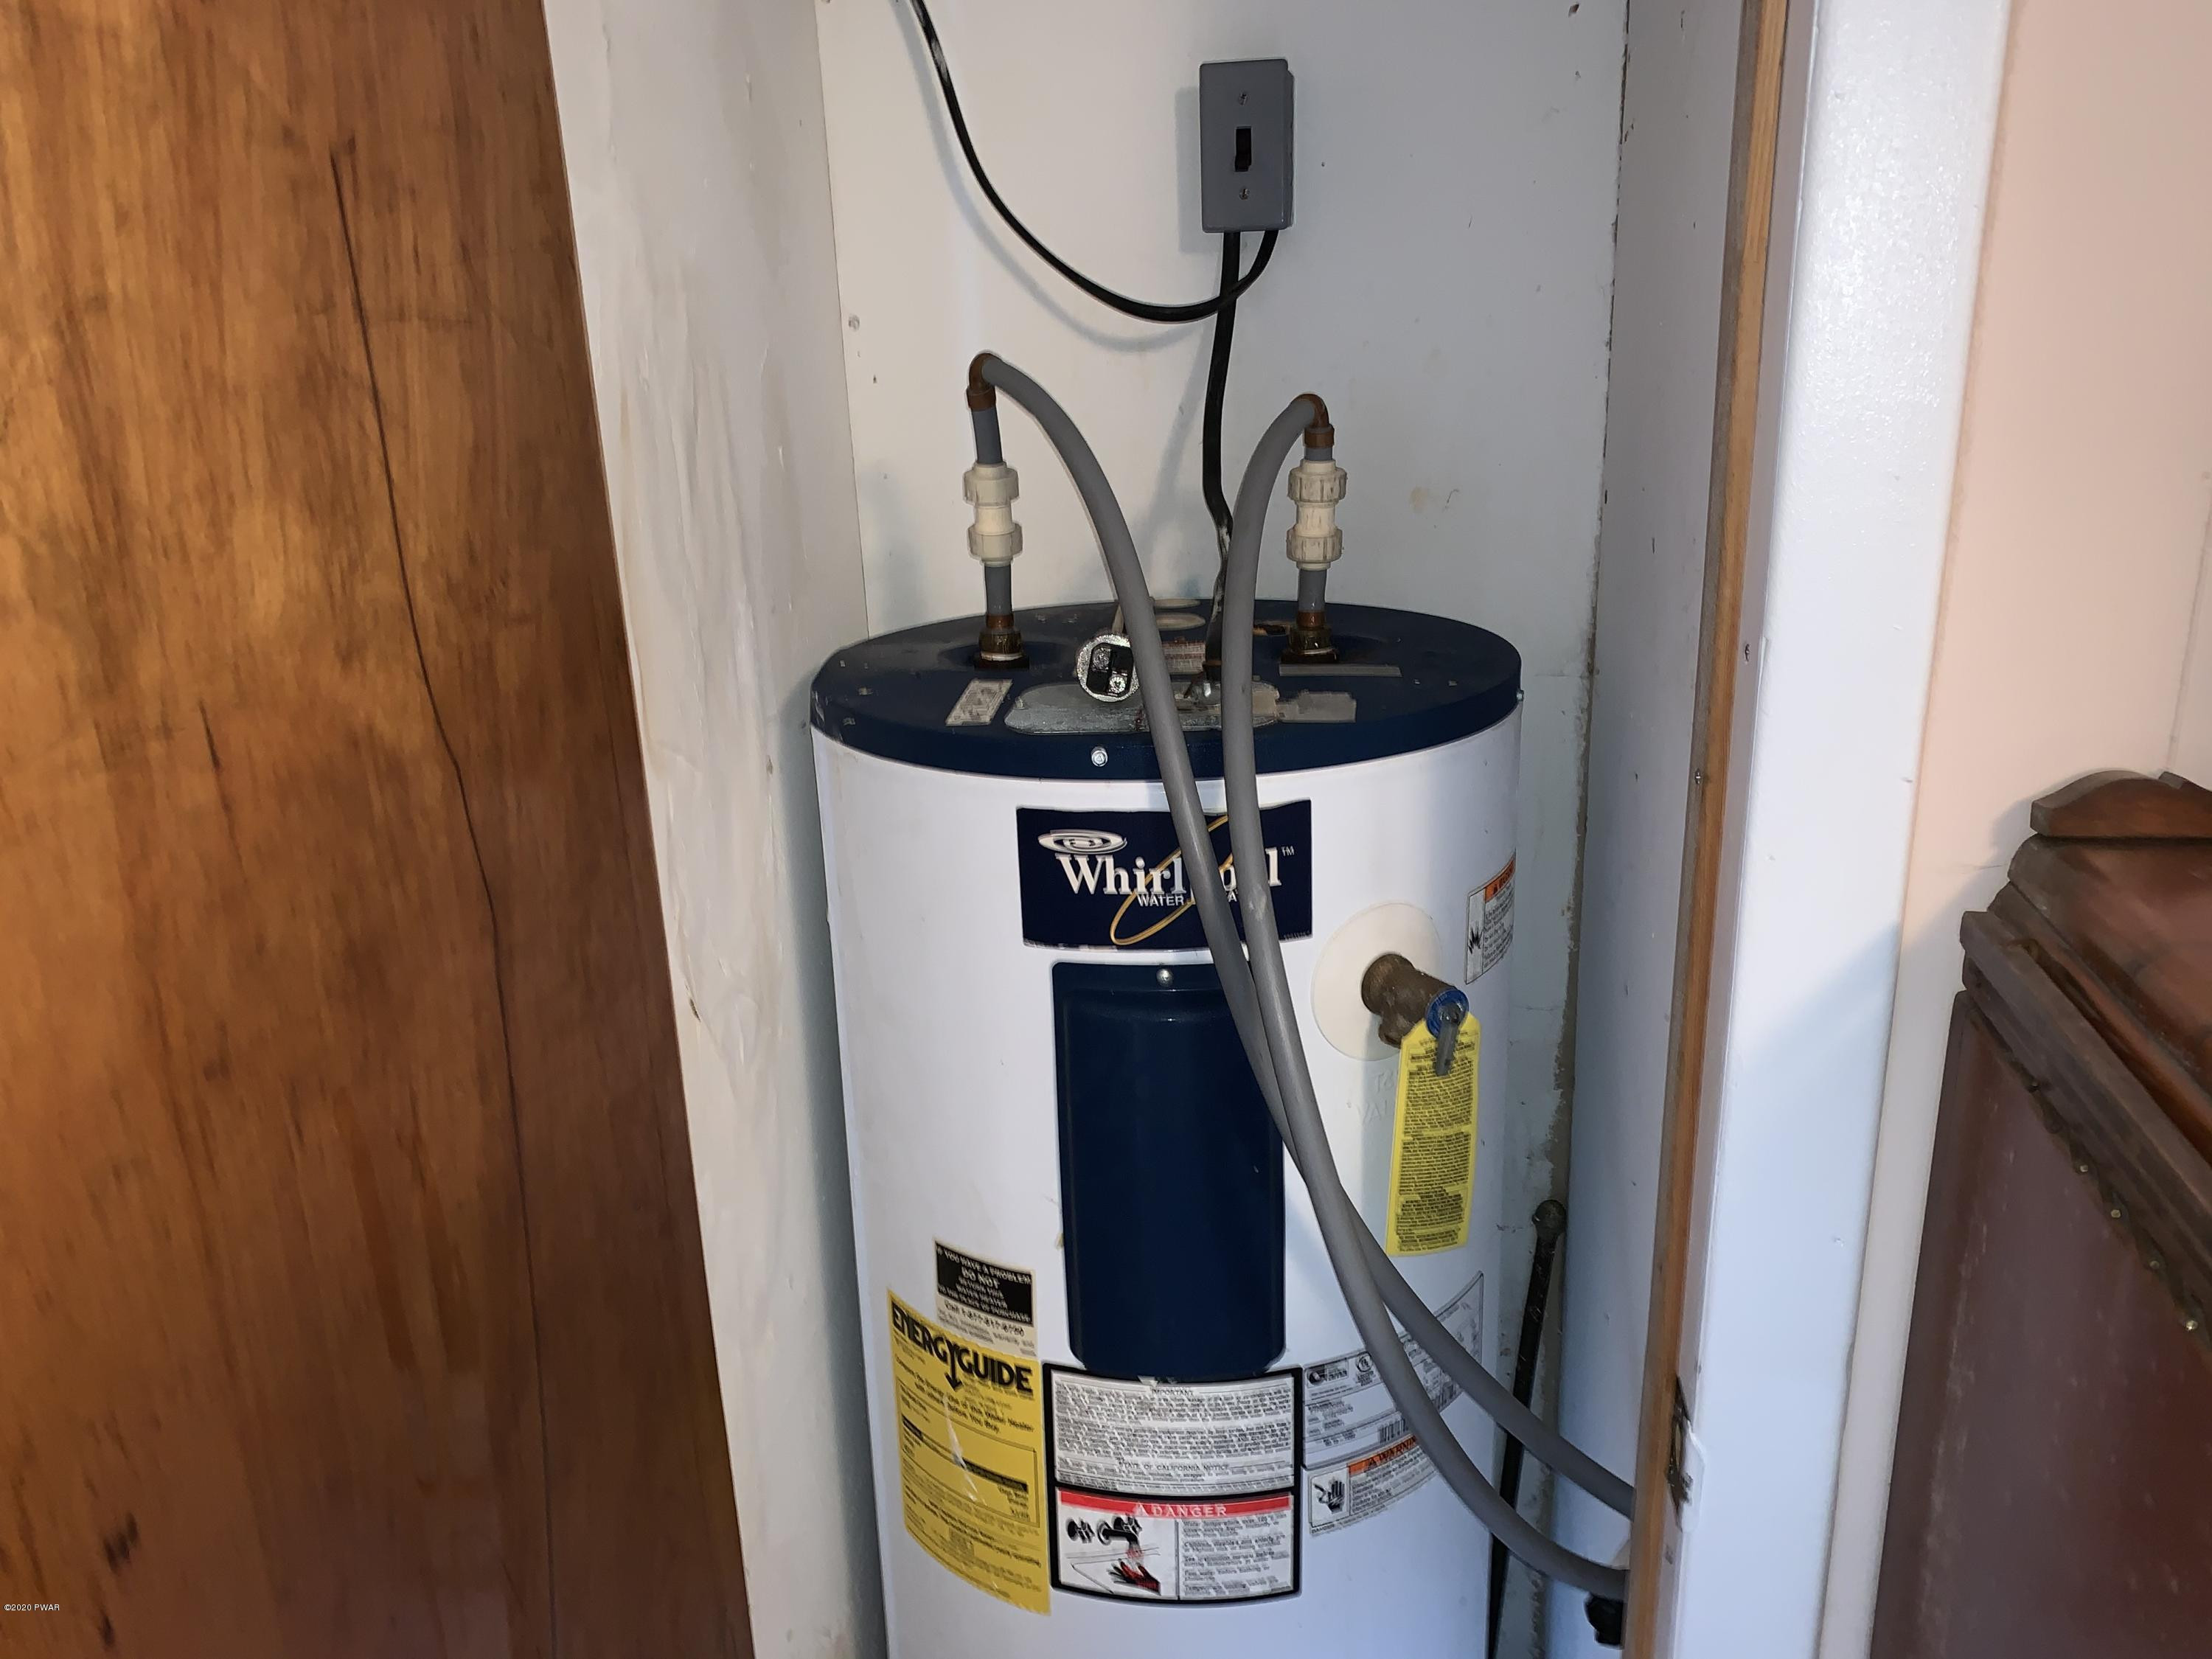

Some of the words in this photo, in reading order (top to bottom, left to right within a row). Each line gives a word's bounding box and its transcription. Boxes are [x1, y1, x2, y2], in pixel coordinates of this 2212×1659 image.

[1055, 846, 1281, 905] Whirlol
[1138, 894, 1184, 907] WATER
[961, 1266, 976, 1281] DO
[978, 1273, 1000, 1289] NOT
[990, 1265, 1031, 1284] PROBLEM
[1151, 1503, 1227, 1517] DANGER
